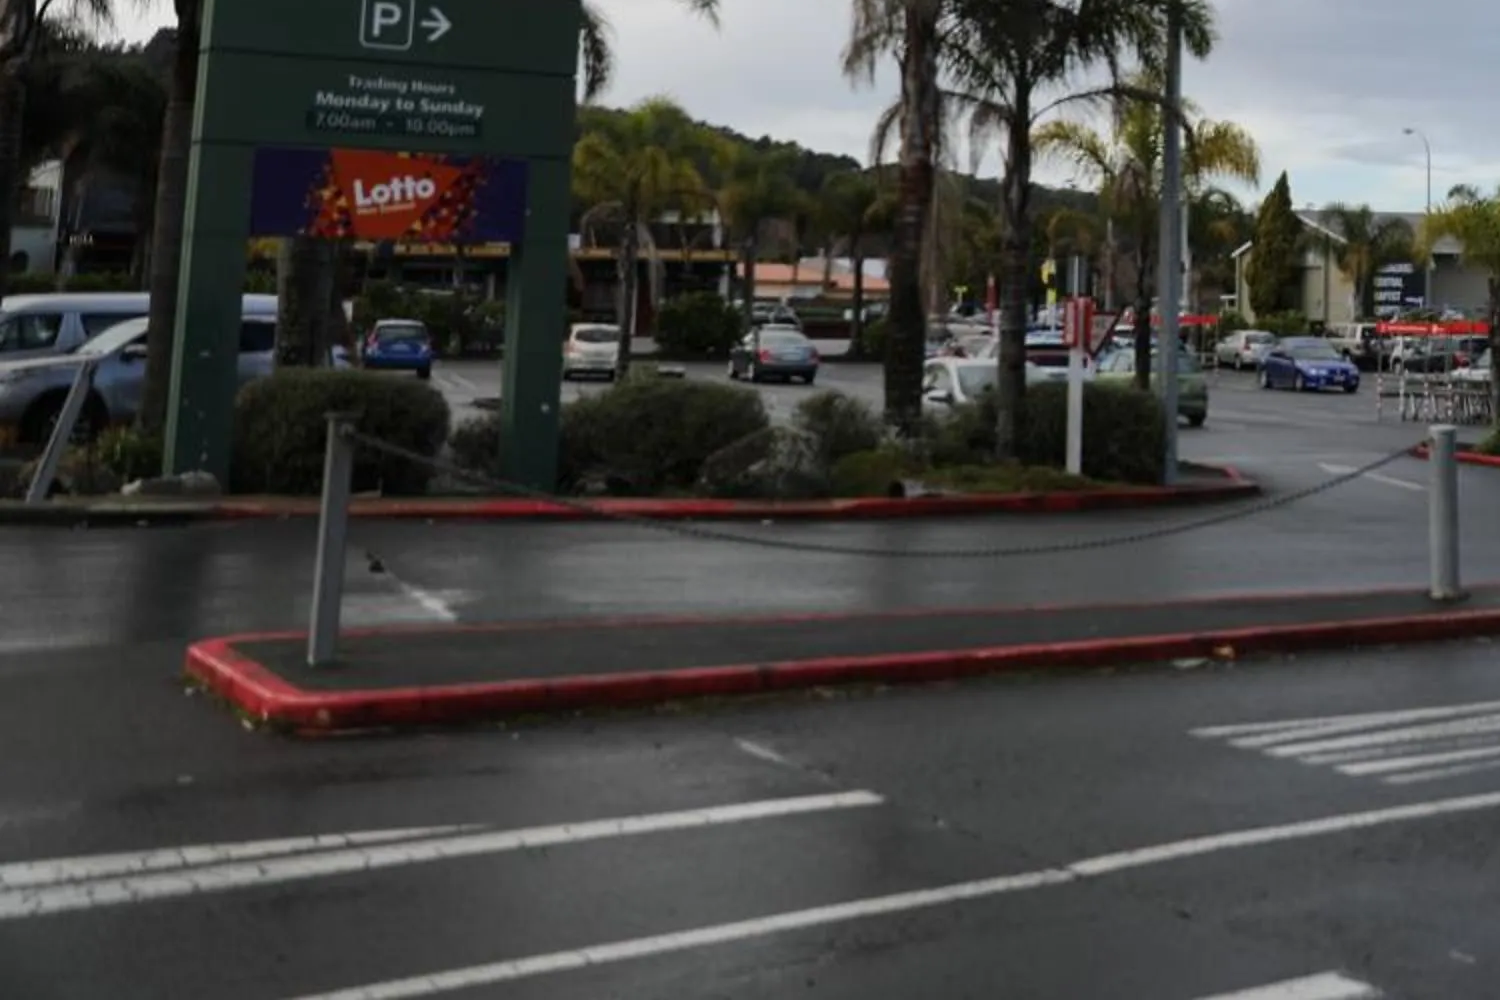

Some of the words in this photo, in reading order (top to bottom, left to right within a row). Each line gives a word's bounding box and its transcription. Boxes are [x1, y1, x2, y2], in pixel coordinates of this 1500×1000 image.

[372, 2, 402, 37] P
[349, 74, 408, 94] Trading
[411, 80, 456, 95] Hours
[315, 90, 391, 113] Monday
[396, 97, 415, 112] to
[420, 97, 485, 119] Sunday
[353, 174, 436, 208] Lotto
